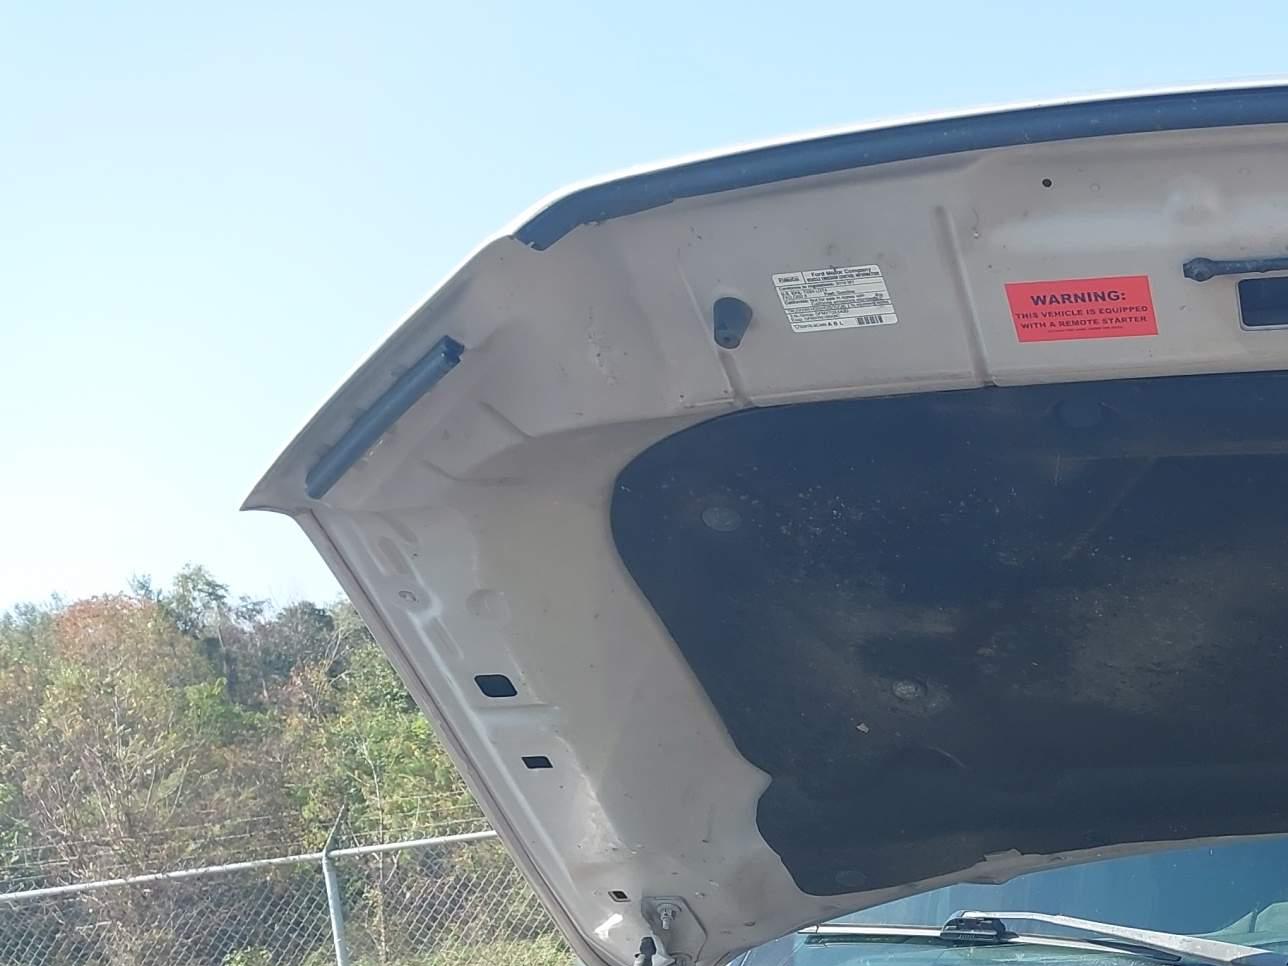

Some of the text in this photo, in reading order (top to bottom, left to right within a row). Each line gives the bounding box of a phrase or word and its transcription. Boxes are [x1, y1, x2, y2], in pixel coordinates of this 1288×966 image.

[1031, 290, 1126, 306] WARNING:
[1015, 312, 1039, 320] THIS
[1041, 309, 1082, 318] VEHICLE
[1098, 305, 1148, 315] EQUIPPED
[1020, 315, 1148, 329] WITH A REMOTE STARTER
